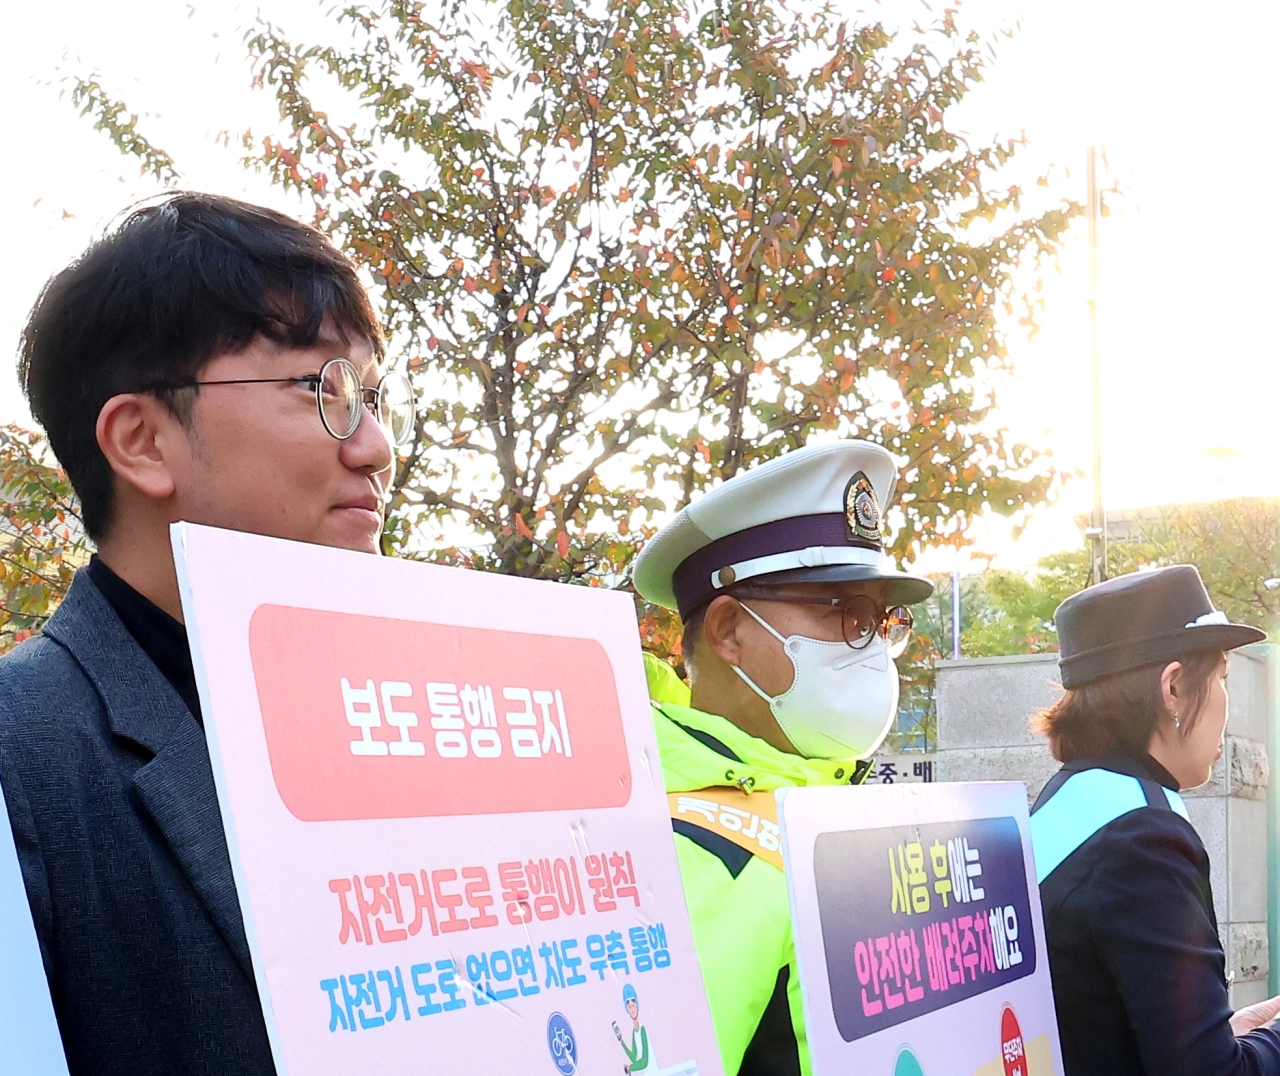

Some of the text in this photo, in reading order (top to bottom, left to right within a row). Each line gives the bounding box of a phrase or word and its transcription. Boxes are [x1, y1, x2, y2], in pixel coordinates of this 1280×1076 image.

[340, 677, 573, 758] 보도 통행 금지
[329, 850, 641, 945] 자전거도로 통행이 원칙
[888, 836, 985, 916] 사용 후에는
[320, 922, 671, 1033] 자전거 도로 없으면 차도 우측 통행
[854, 905, 1023, 1017] 안전한 배려주차해요
